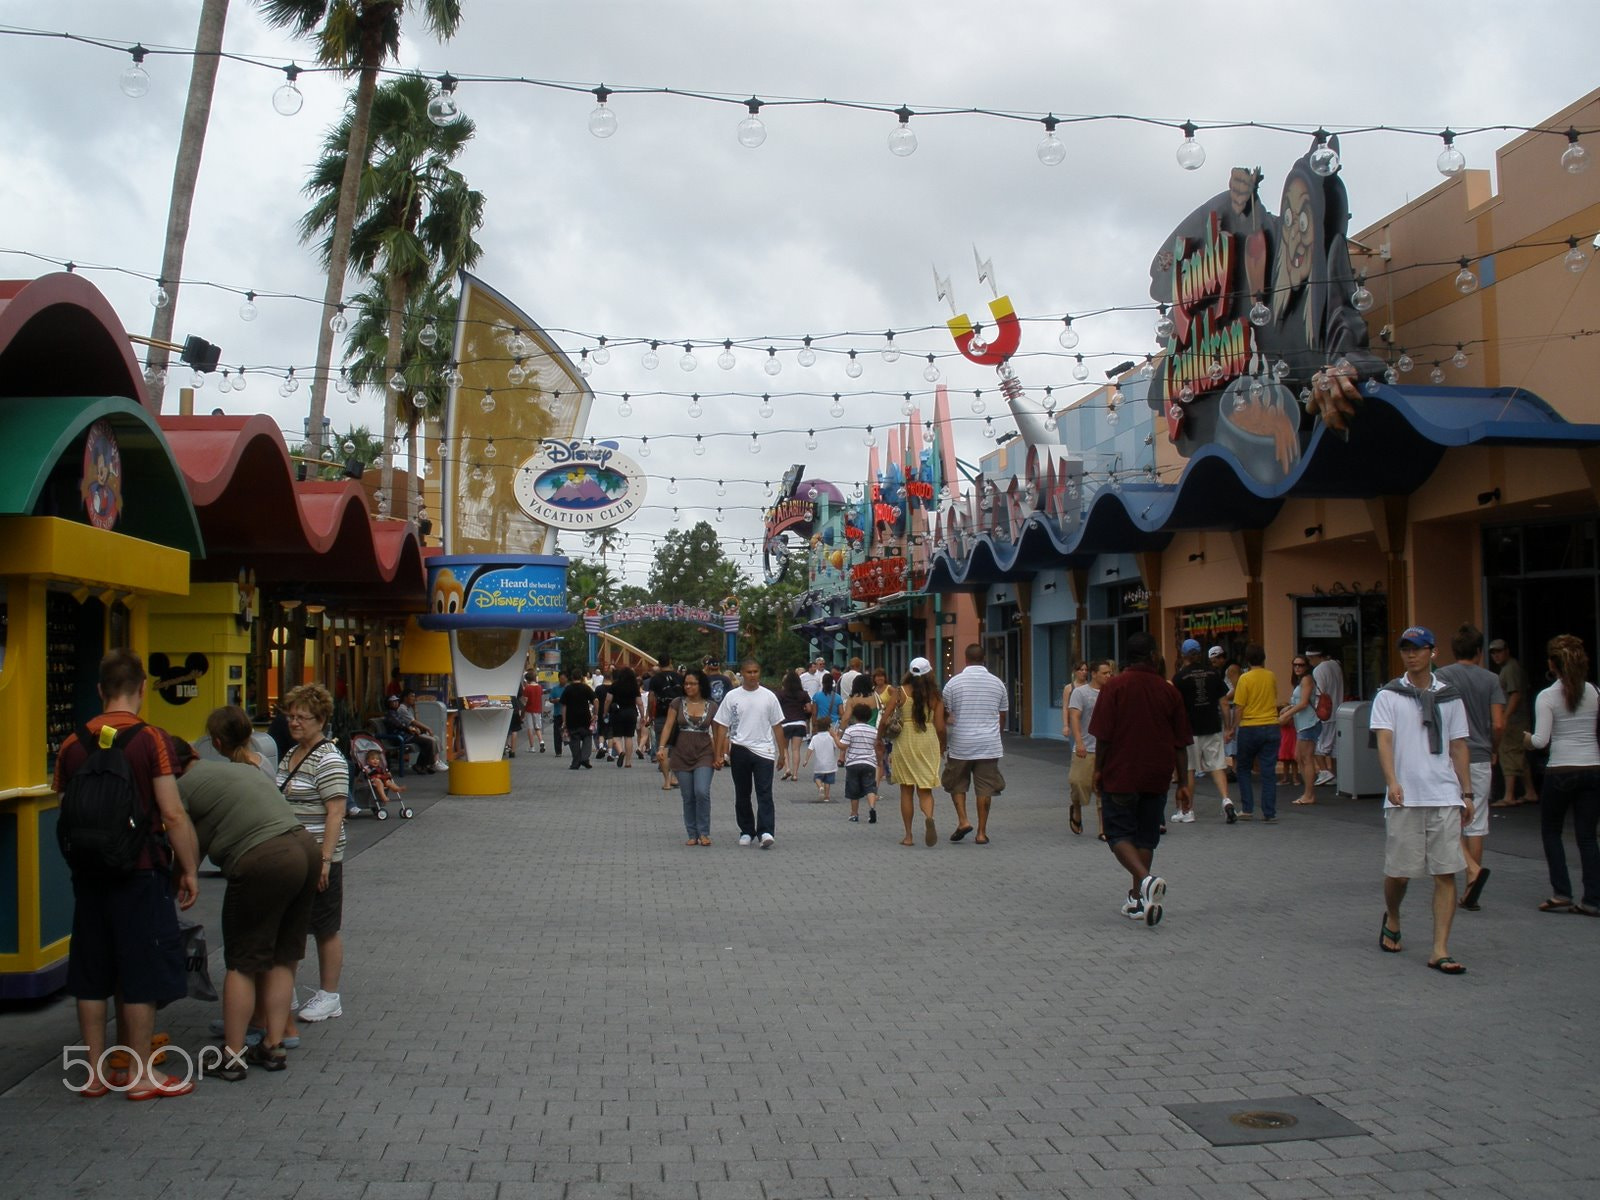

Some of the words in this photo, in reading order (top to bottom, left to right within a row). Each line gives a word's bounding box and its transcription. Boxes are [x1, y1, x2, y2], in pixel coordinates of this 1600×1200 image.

[1172, 210, 1234, 345] Candy
[1163, 306, 1250, 440] Cauldron
[542, 440, 613, 469] Disney
[528, 499, 594, 523] VACATION
[600, 498, 634, 521] CLUB
[500, 578, 528, 588] Heard
[471, 589, 527, 613] Disney
